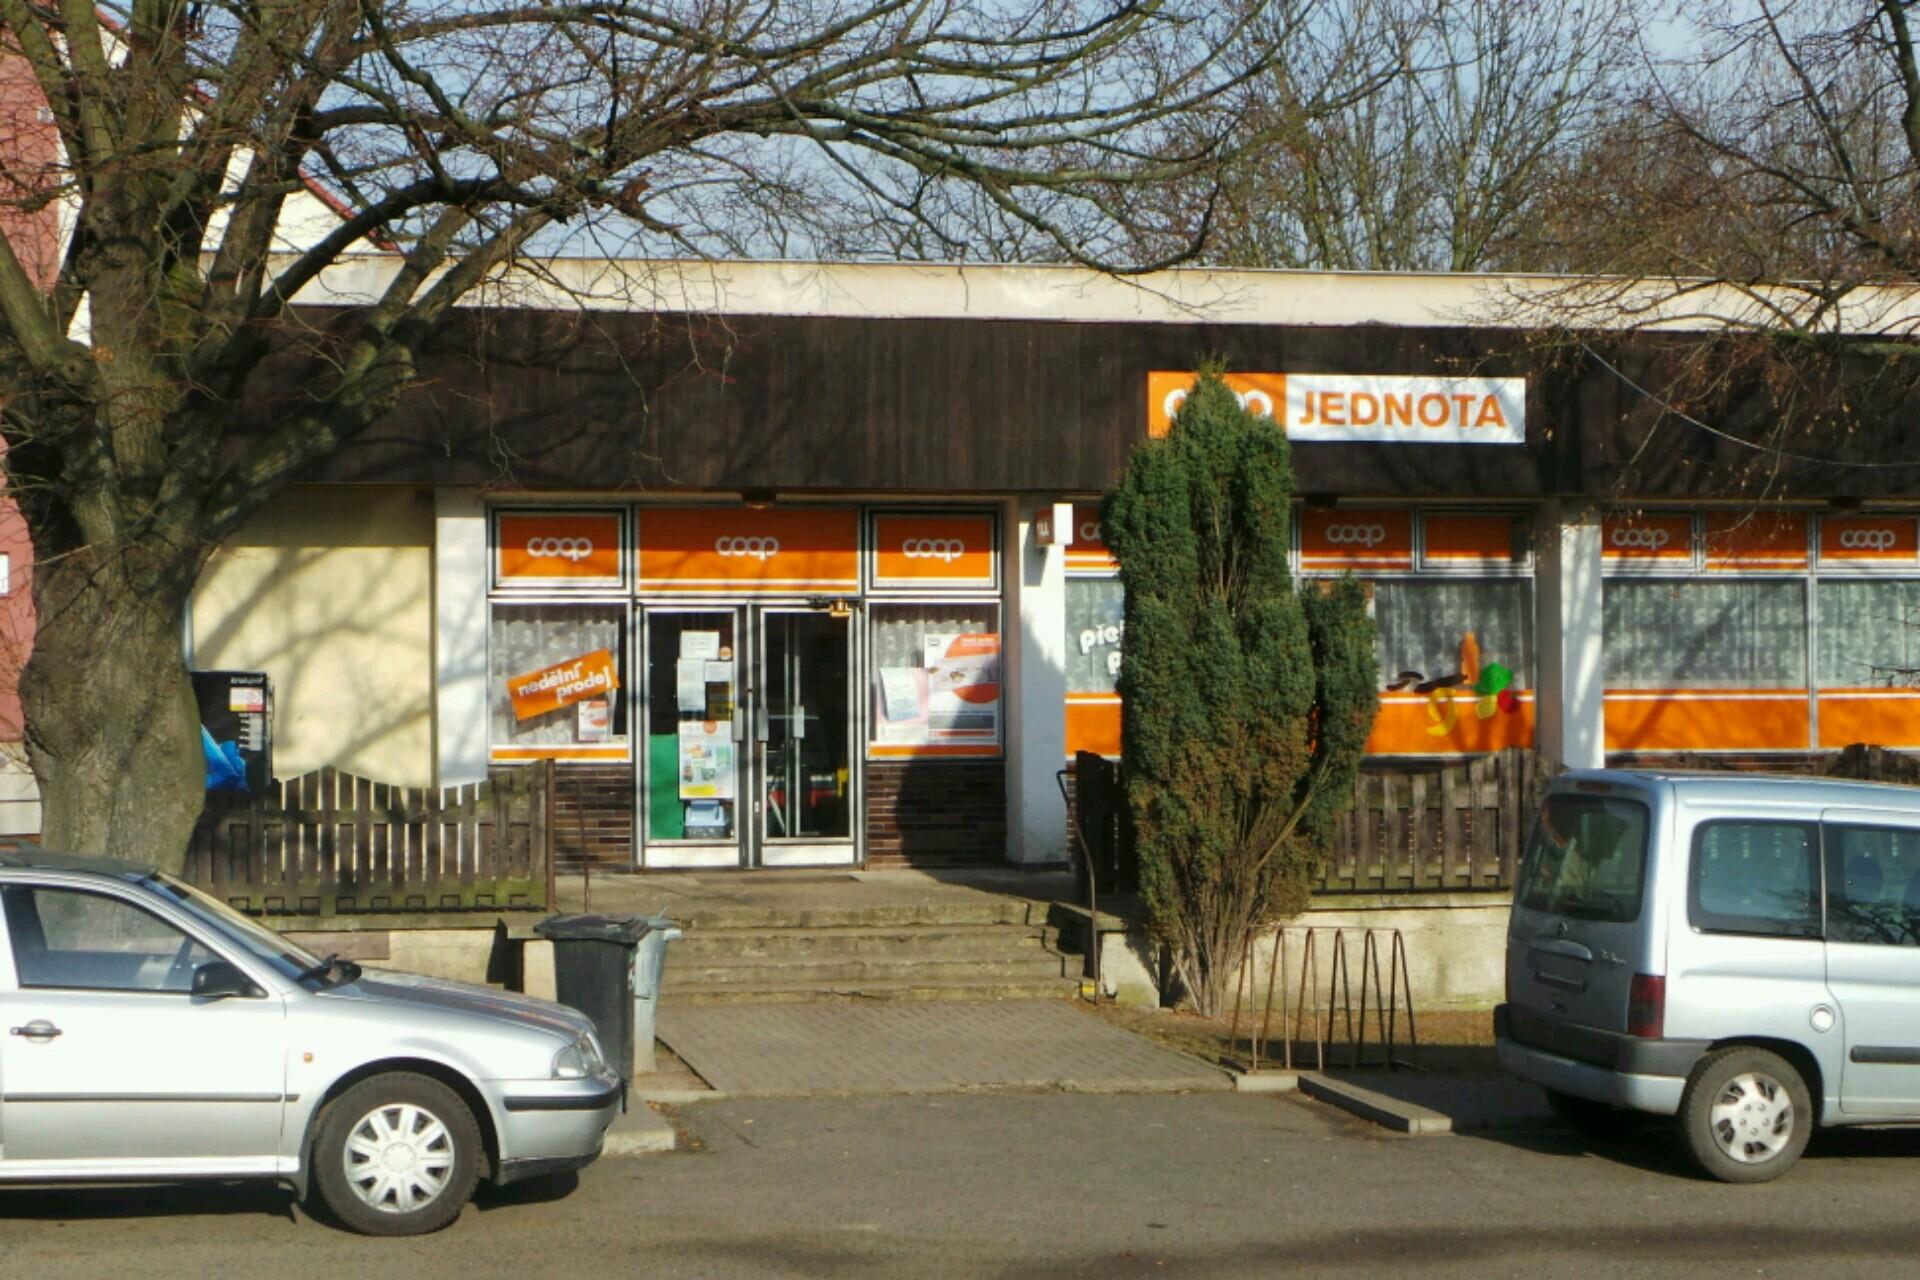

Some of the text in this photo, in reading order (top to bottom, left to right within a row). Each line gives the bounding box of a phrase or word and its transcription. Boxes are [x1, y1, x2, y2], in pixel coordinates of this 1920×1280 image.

[1299, 391, 1506, 428] JEDNOTA
[715, 536, 779, 561] coop
[1326, 524, 1385, 548] coop
[1611, 529, 1669, 551] coop
[1840, 529, 1896, 552] coop
[527, 537, 593, 562] coop
[902, 538, 965, 563] coop
